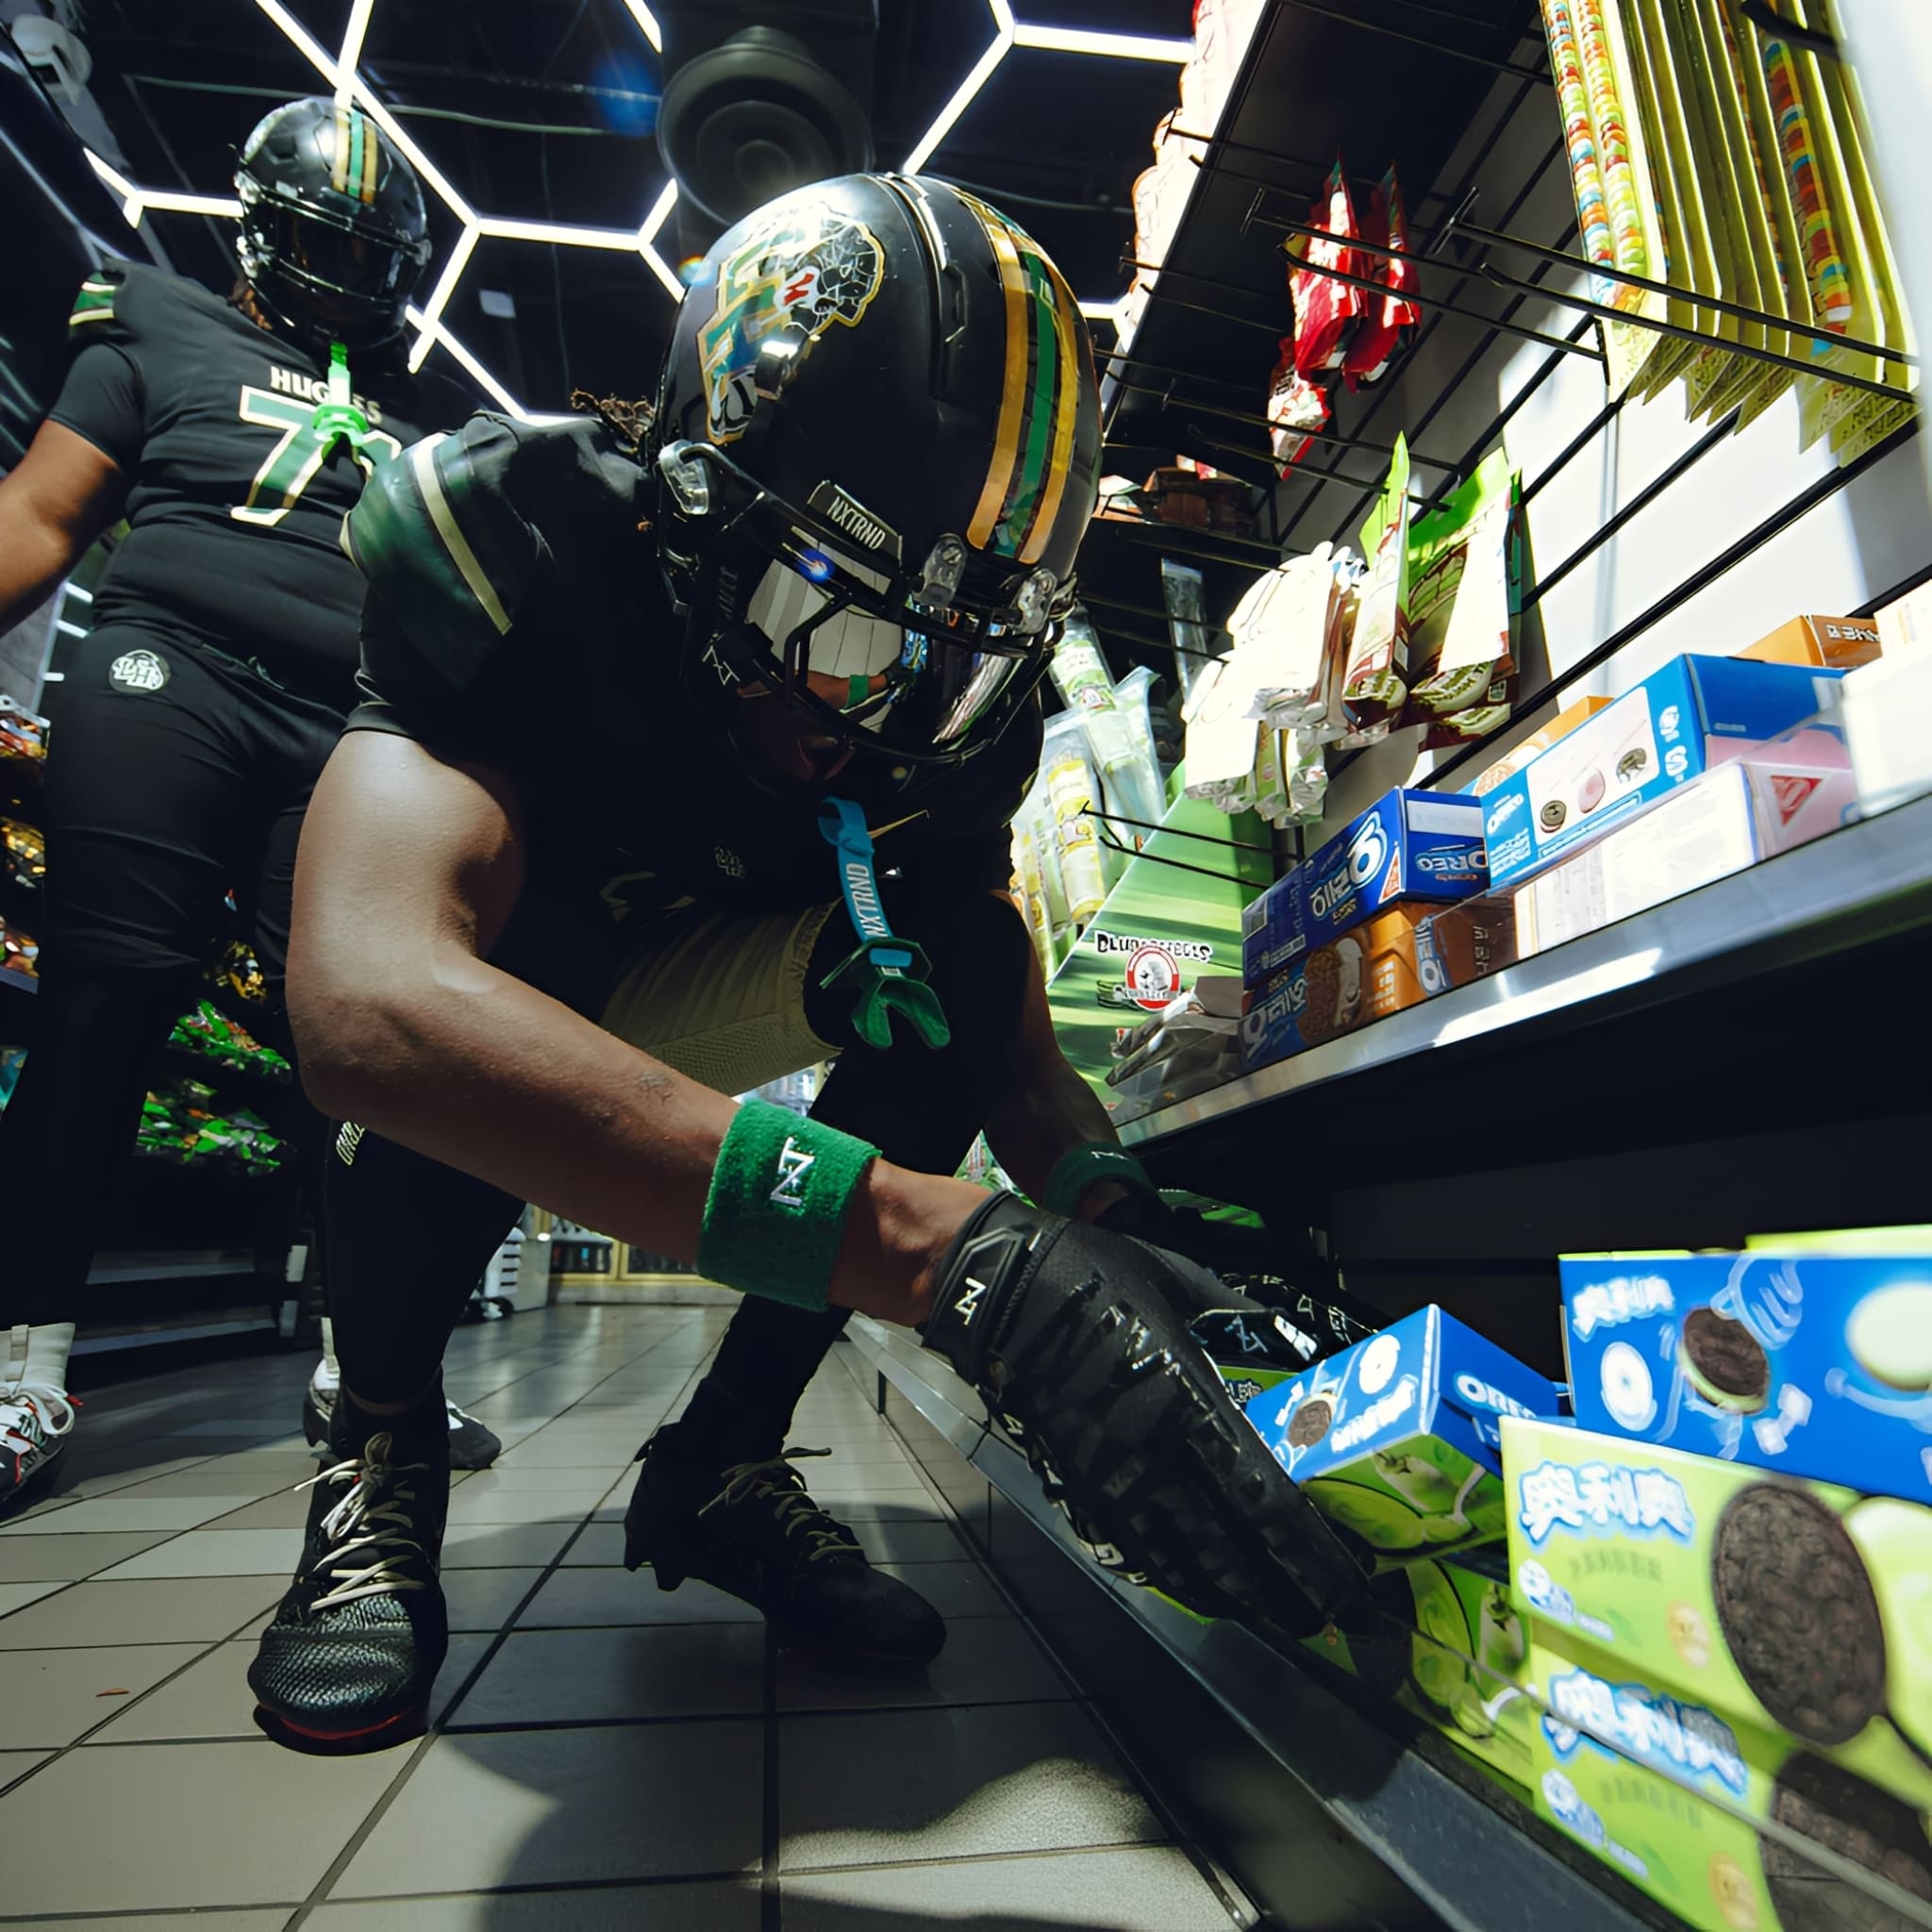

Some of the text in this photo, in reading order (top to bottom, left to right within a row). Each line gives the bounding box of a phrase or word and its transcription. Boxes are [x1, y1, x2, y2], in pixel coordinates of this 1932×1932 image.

[270, 365, 383, 425] HUGES
[826, 496, 886, 550] NXTRND
[1417, 850, 1488, 872] OREO
[846, 862, 889, 937] NXTRND
